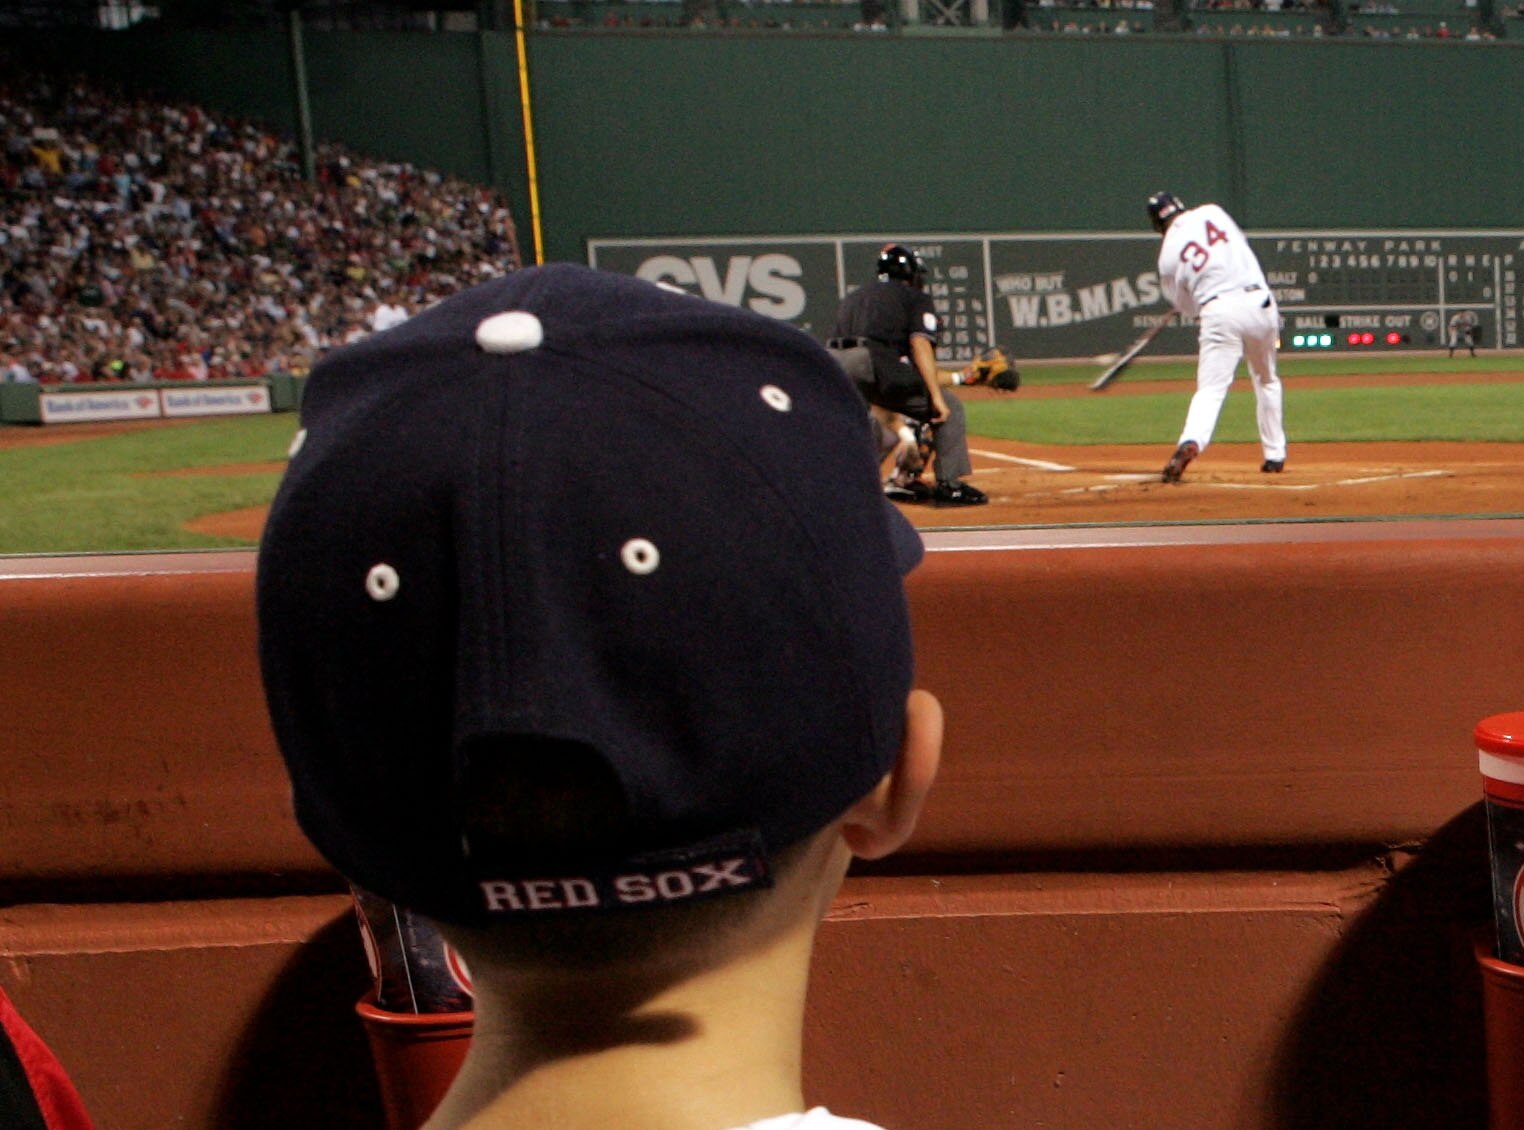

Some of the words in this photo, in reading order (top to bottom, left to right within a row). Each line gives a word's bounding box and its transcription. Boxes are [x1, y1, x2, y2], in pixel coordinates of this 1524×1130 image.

[1180, 219, 1229, 273] 34
[1277, 240, 1367, 253] FENWAY
[1385, 240, 1441, 252] PARK
[1320, 254, 1330, 268] 2
[1347, 254, 1358, 267] 4
[1360, 254, 1369, 268] 5
[1386, 254, 1395, 267] 7
[995, 274, 1032, 293] WHO
[1035, 272, 1065, 291] BUT
[1267, 271, 1297, 285] BALT
[1007, 271, 1159, 328] W.B.MAS
[1295, 315, 1326, 329] BALL
[1338, 315, 1380, 329] STRIKE
[1384, 315, 1412, 328] OUT
[479, 877, 599, 912] RED
[613, 857, 752, 904] SOX
